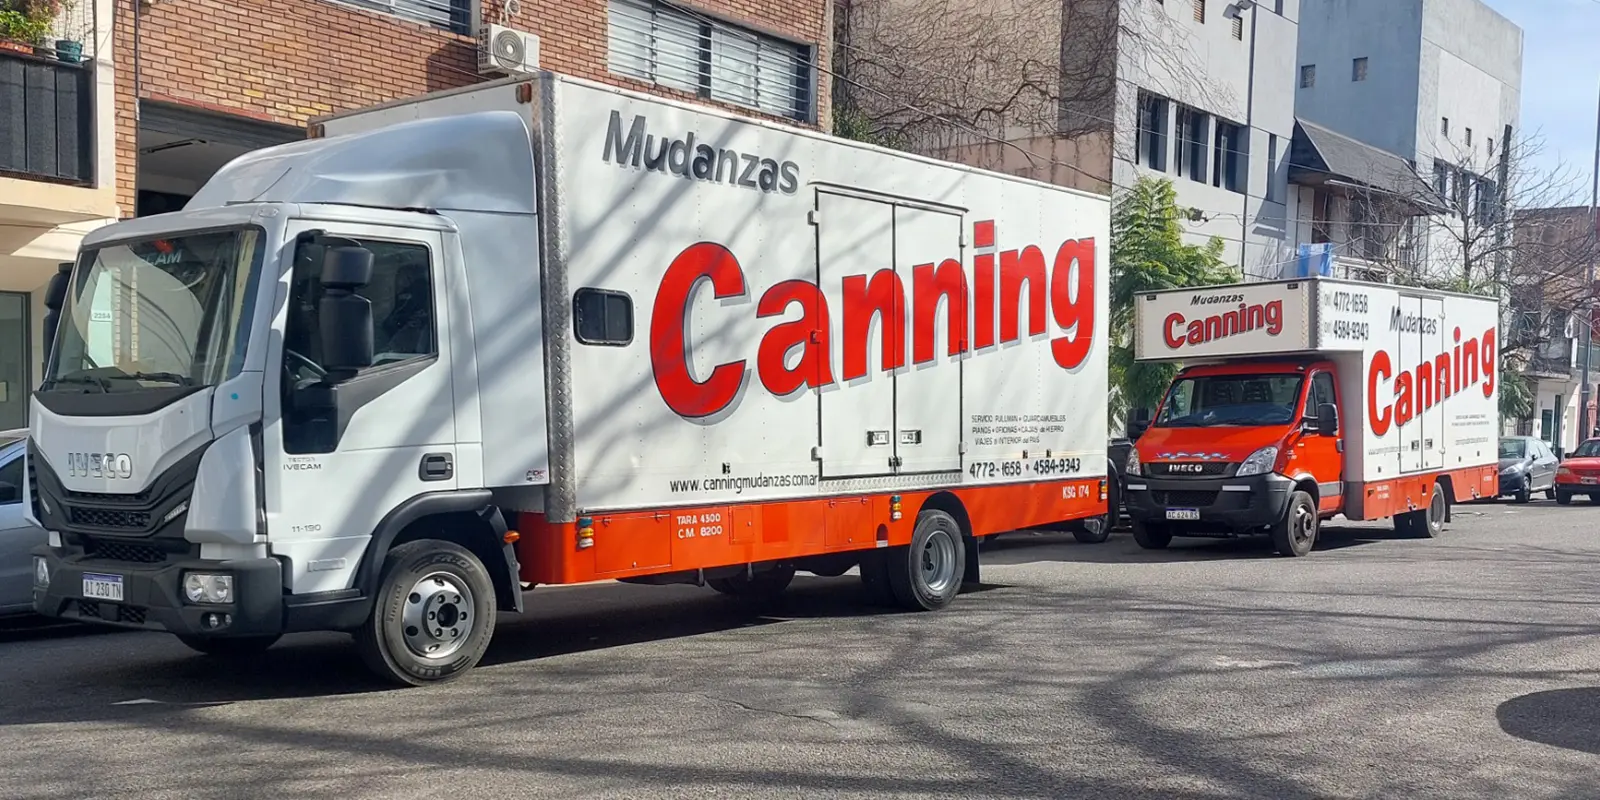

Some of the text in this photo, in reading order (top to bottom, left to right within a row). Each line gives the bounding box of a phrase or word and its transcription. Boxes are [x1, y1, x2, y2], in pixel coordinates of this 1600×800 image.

[602, 110, 800, 196] Mudanzas
[1191, 294, 1244, 305] Mudanzas
[1334, 291, 1368, 313] 4772-1658
[650, 220, 1095, 419] Canning
[1164, 299, 1283, 349] Canning
[1389, 306, 1437, 335] Mudanzas
[1334, 320, 1369, 340] 4584-9343
[1368, 326, 1495, 437] Canning
[971, 415, 993, 423] SERVICIO
[68, 453, 132, 479] IVECO
[970, 458, 1080, 478] 4772-1658 4584-9343
[1168, 464, 1203, 472] IVECO
[1062, 486, 1076, 499] KSG
[292, 524, 321, 532] 11-190
[677, 515, 697, 525] TARA
[700, 526, 722, 537] 8200
